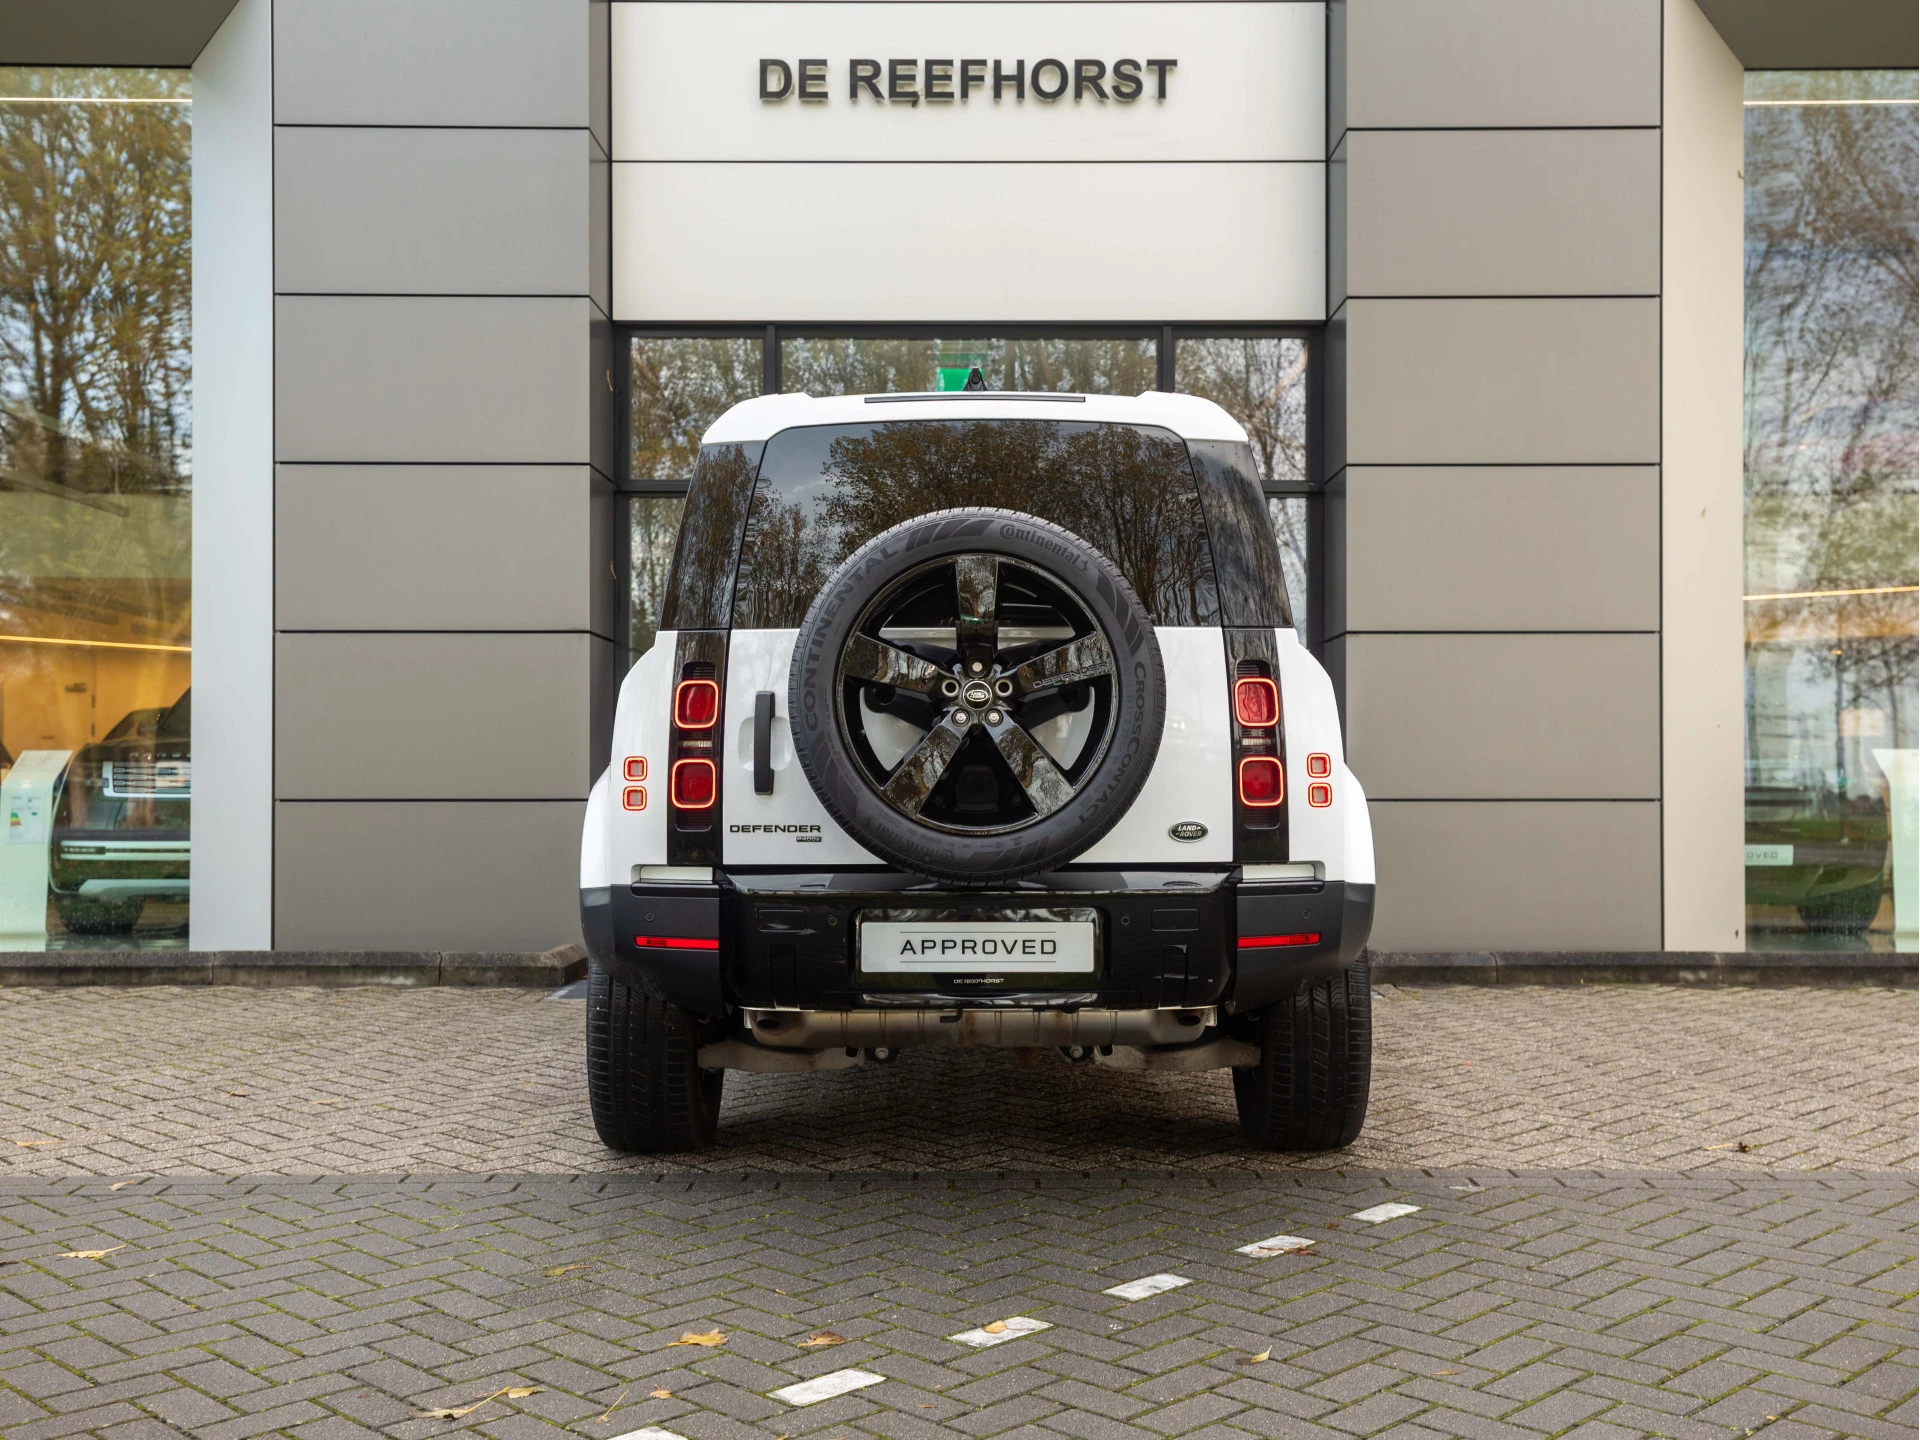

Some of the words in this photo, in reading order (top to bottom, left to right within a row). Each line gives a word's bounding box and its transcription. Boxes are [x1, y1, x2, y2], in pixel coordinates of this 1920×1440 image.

[759, 58, 829, 100] DE
[848, 58, 1178, 101] REEFHORST
[1000, 523, 1082, 566] Continental
[803, 549, 899, 732] CONTINENTAL
[729, 824, 822, 834] DEFENDER
[1746, 851, 1779, 860] OVED
[900, 939, 1057, 955] APPROVED
